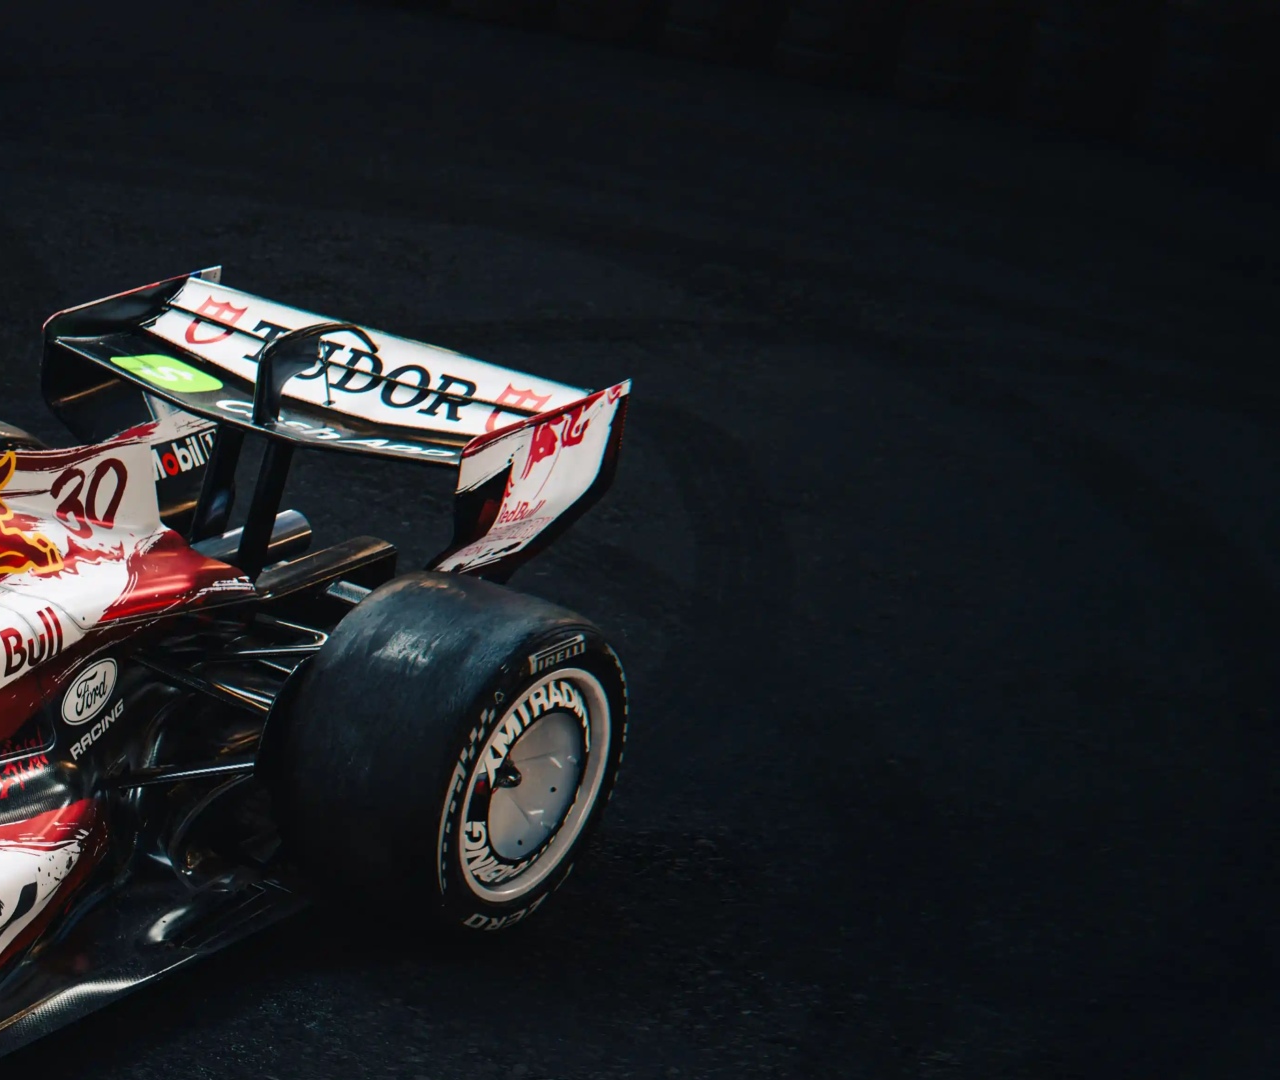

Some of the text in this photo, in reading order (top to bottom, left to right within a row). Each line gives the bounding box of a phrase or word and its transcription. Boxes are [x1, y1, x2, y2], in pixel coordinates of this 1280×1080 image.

[216, 400, 340, 440] Csh
[50, 458, 128, 539] 30
[3, 608, 62, 675] Bull
[529, 634, 586, 675] PIRELLI
[75, 665, 107, 715] Ford
[69, 699, 124, 761] RACING
